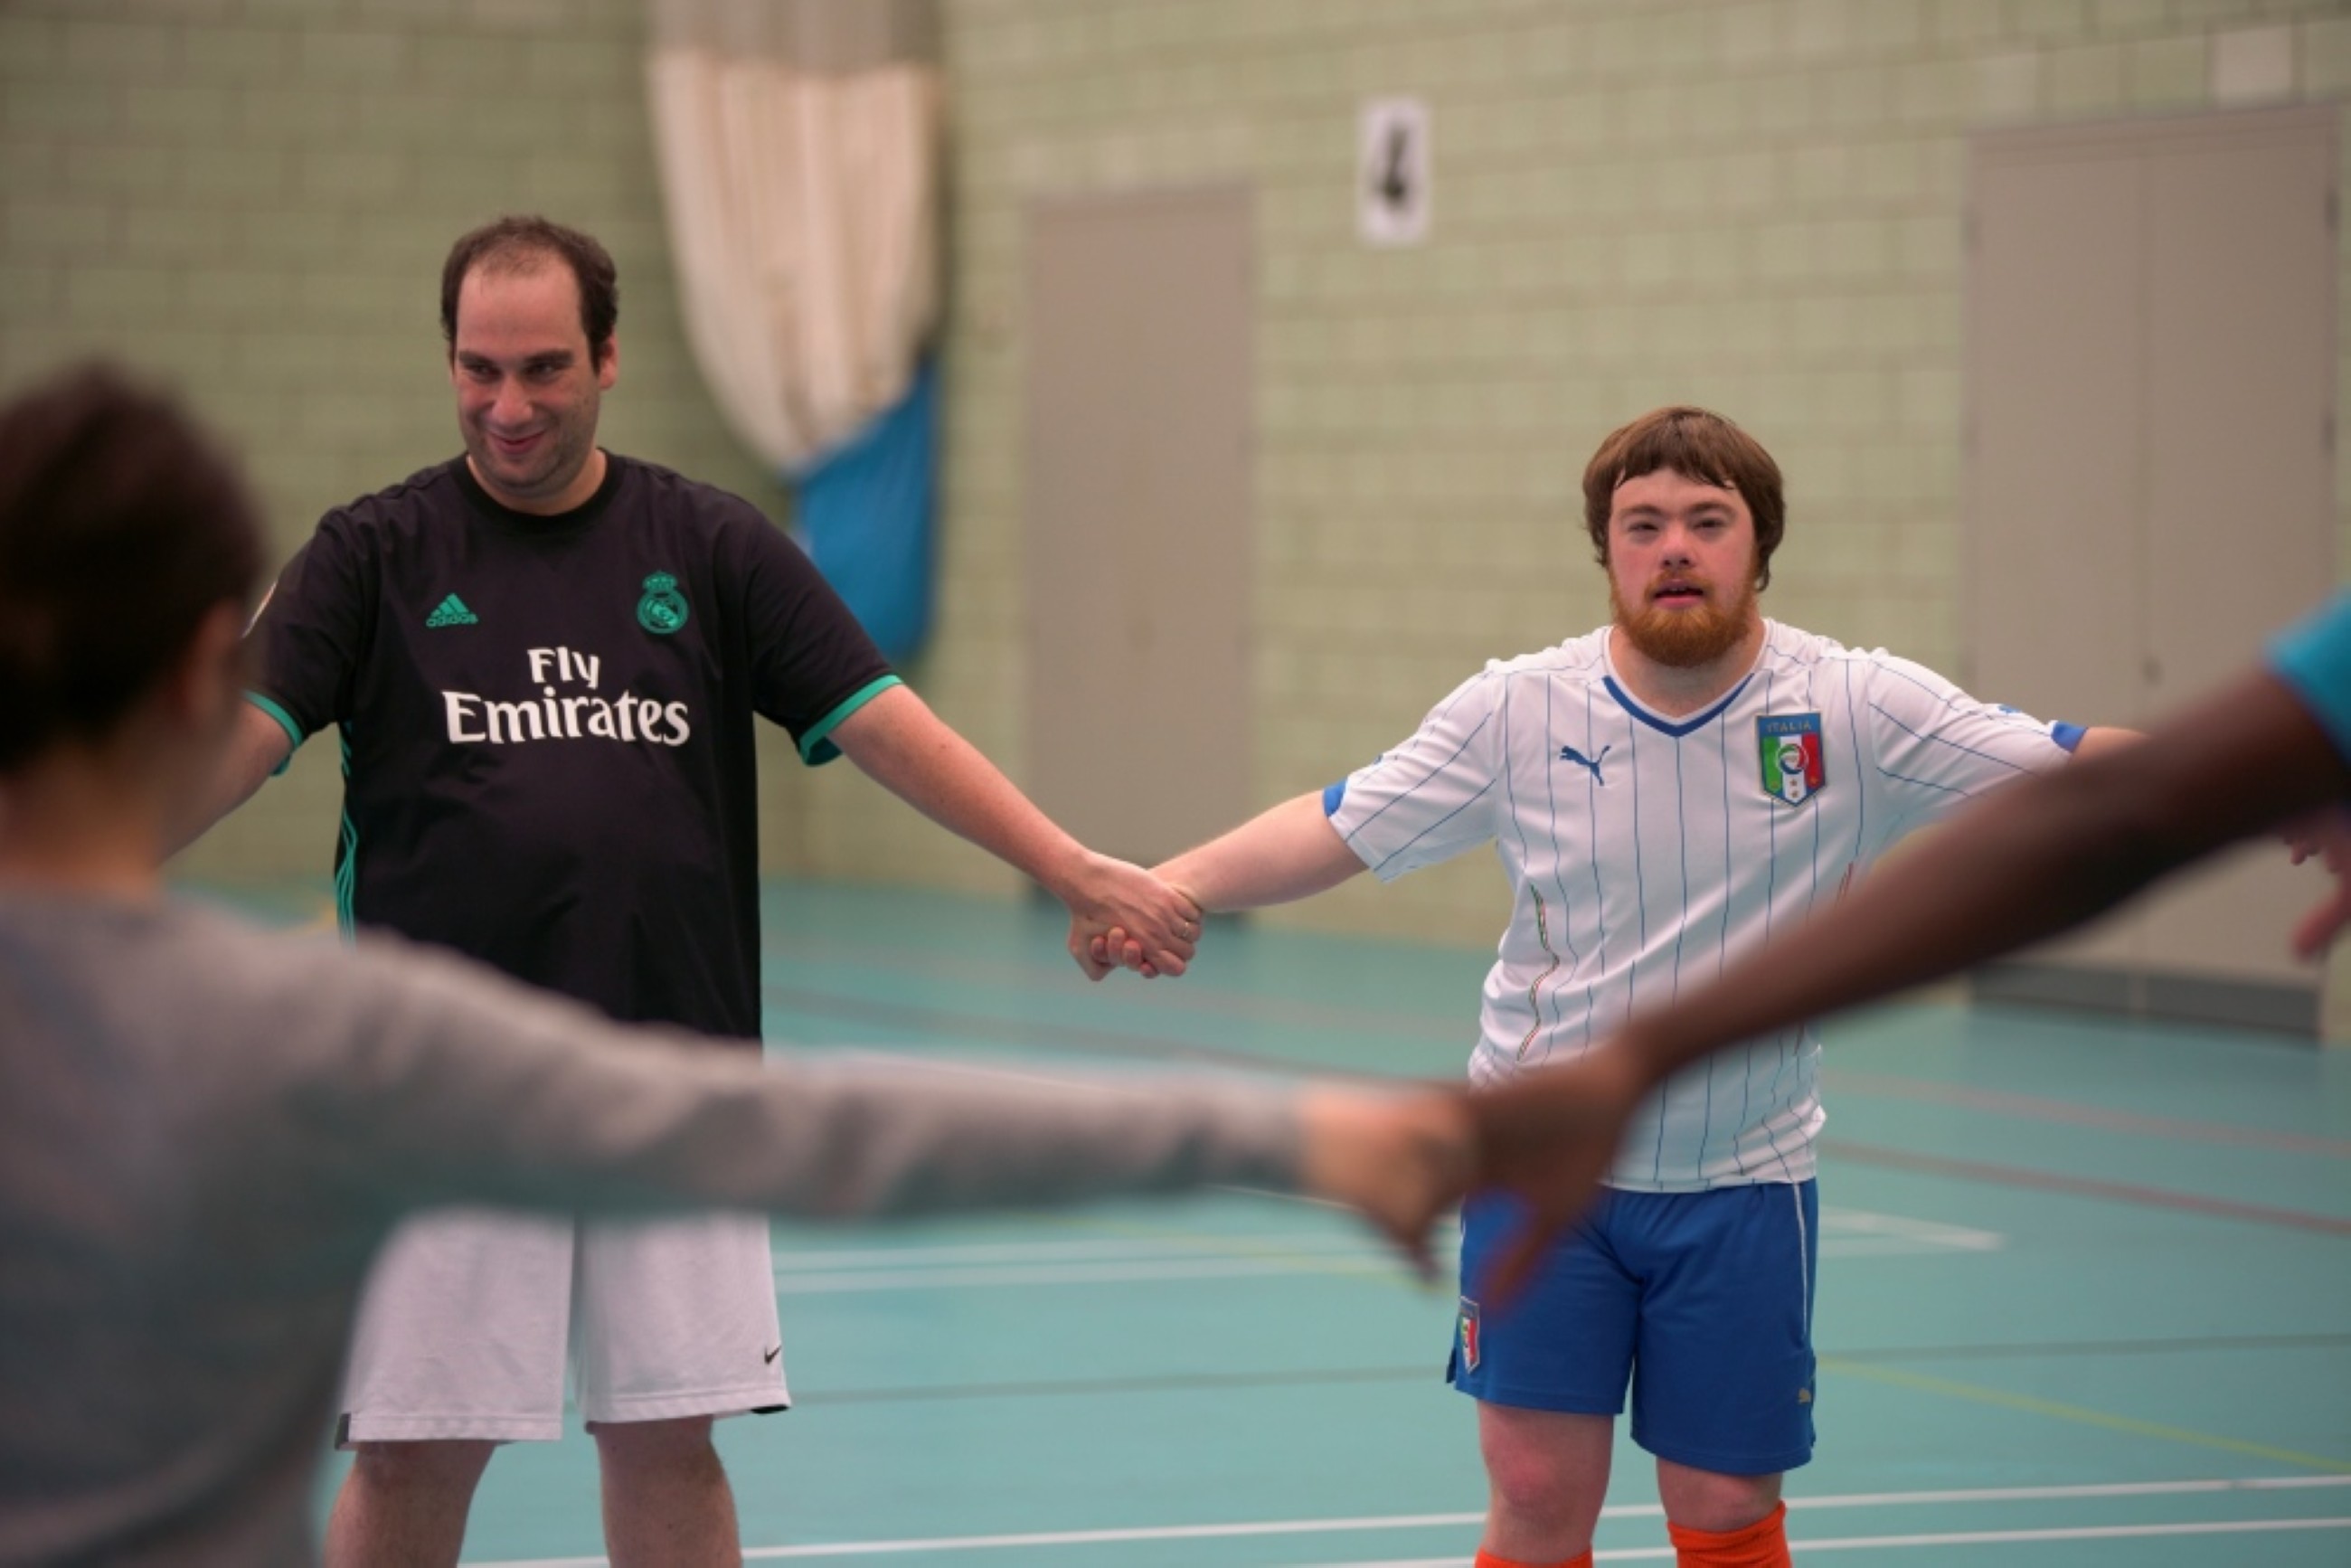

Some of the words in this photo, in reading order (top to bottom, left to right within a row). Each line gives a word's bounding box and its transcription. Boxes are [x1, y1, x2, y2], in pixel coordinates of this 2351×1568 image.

[426, 613, 478, 628] adidas
[527, 646, 600, 690] Fly
[441, 685, 691, 747] Emirates
[1766, 720, 1812, 733] ITALIA
